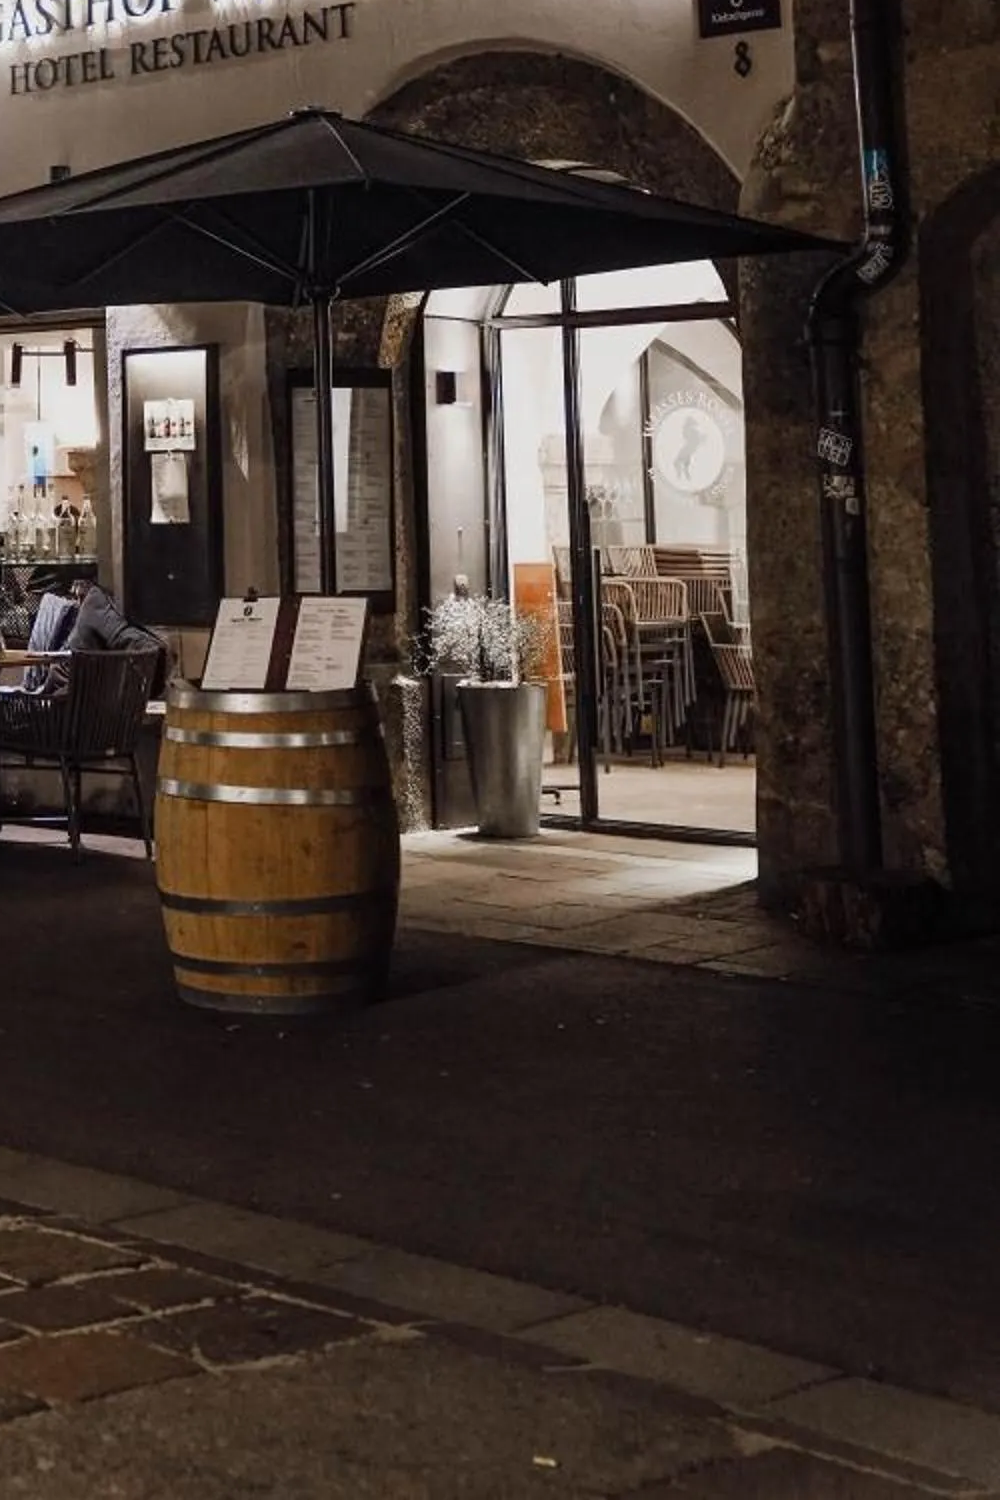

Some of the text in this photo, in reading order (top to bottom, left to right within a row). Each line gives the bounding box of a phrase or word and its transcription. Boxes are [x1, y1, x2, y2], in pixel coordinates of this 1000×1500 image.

[9, 3, 356, 96] HOTEL RESTAURANT
[734, 41, 752, 77] 8
